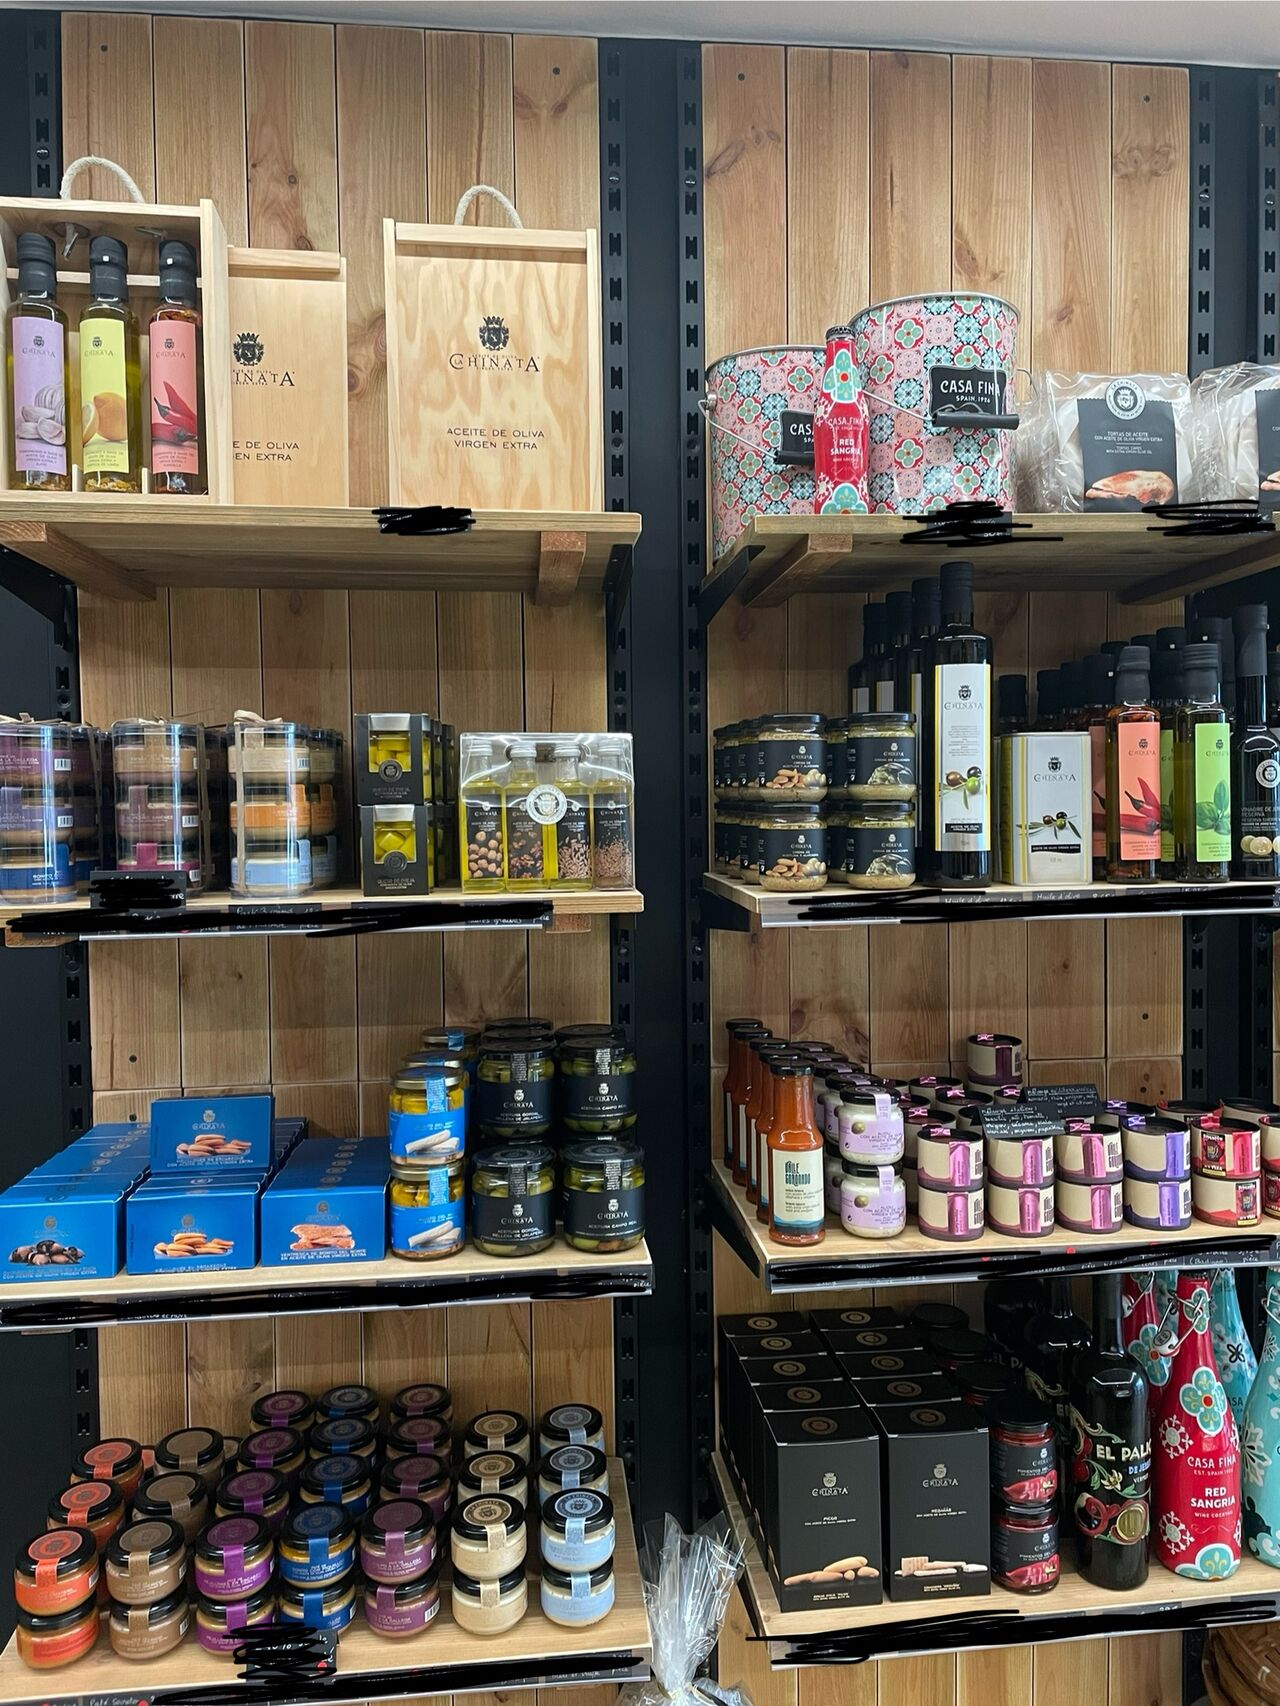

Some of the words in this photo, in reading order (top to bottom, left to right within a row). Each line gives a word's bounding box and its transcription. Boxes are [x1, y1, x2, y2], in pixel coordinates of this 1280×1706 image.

[449, 353, 540, 372] CHINATA
[234, 371, 295, 386] INATA
[940, 380, 973, 394] CASA
[828, 417, 848, 426] CASA
[447, 428, 487, 436] ACEITE
[492, 429, 507, 437] DE
[513, 430, 545, 438] OLIVA
[790, 423, 814, 435] CAS
[246, 441, 261, 449] DE
[267, 442, 299, 450] OLIVA
[454, 440, 497, 449] VIRGEN
[503, 442, 538, 450] EXTRA
[839, 438, 854, 446] RED
[831, 447, 862, 456] SANGRIA
[232, 453, 250, 461] EN
[256, 453, 292, 461] EXTRA
[944, 702, 983, 710] CHINATA
[1034, 774, 1076, 782] CHINATA
[597, 1211, 629, 1220] CHINATA
[501, 1217, 534, 1225] CHINATA
[1096, 1444, 1115, 1461] EL
[1187, 1456, 1213, 1469] CASA
[1219, 1454, 1236, 1466] FINA
[1128, 1465, 1138, 1474] DE
[923, 1478, 958, 1487] CHINATA
[812, 1487, 848, 1497] CHINATA
[1205, 1486, 1227, 1497] RED
[1191, 1496, 1236, 1509] SANGRIA
